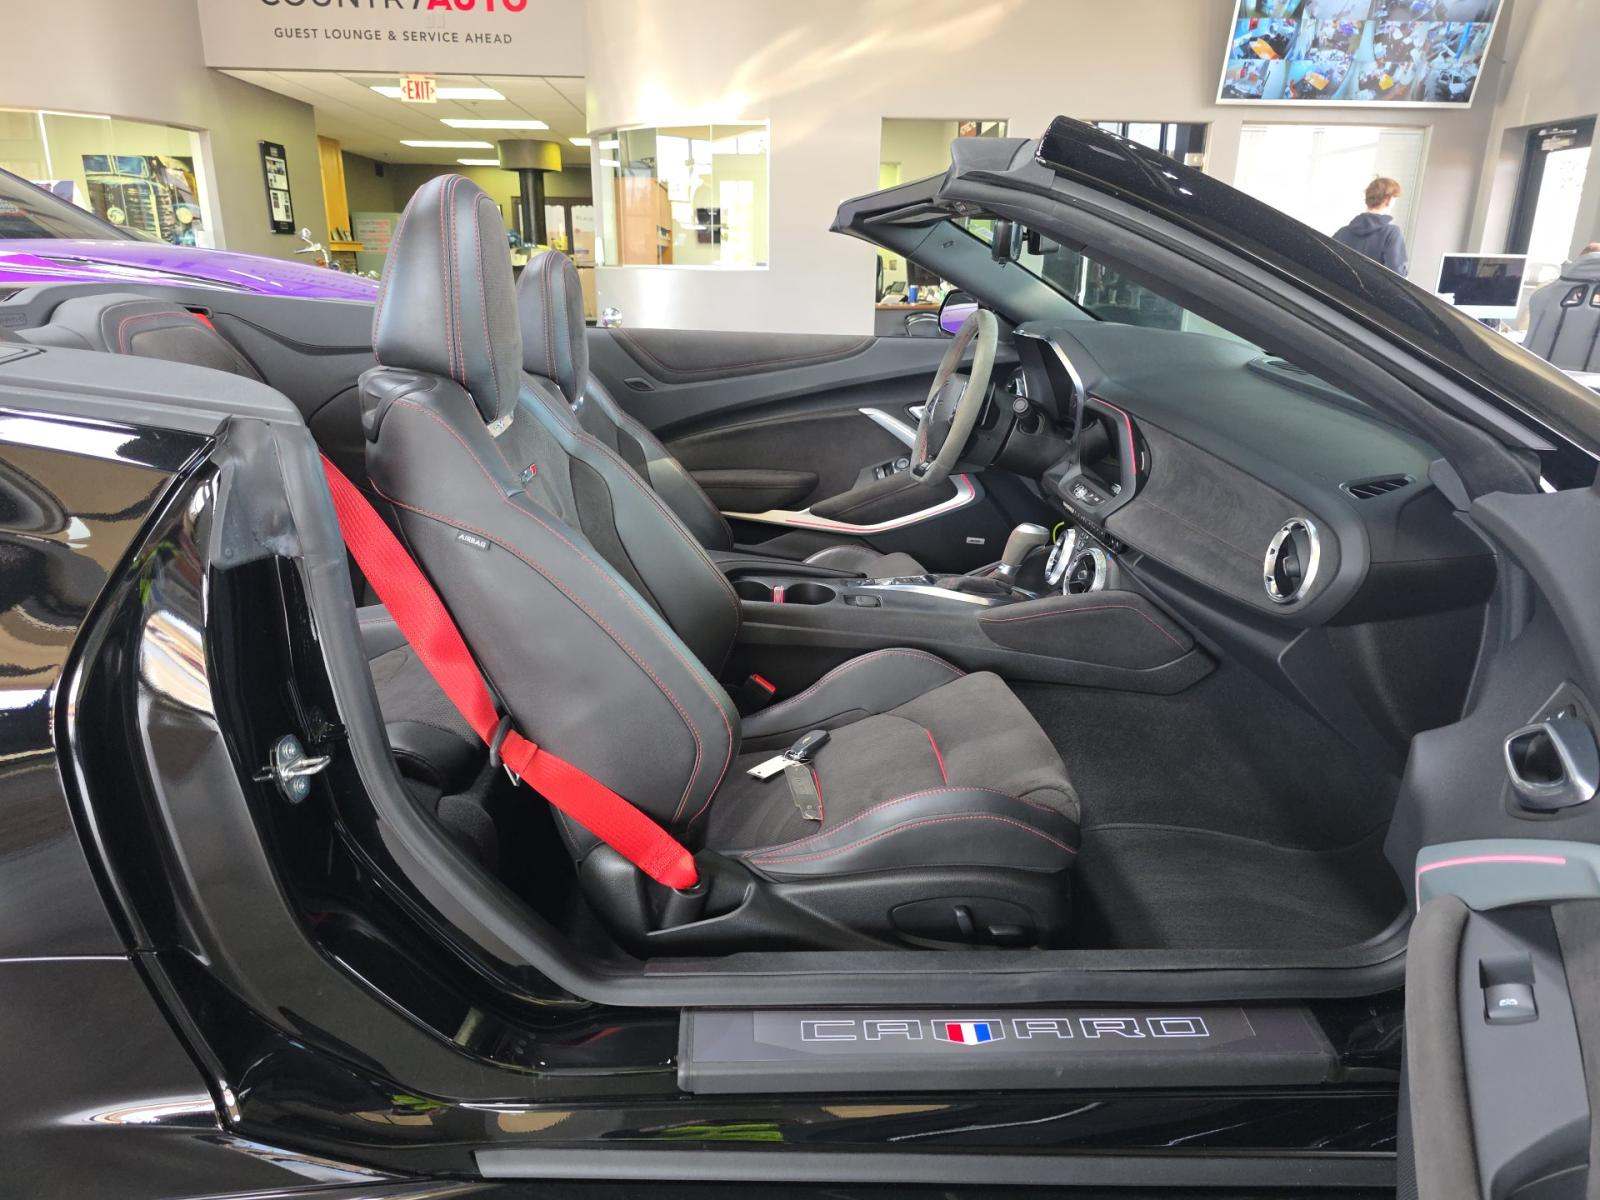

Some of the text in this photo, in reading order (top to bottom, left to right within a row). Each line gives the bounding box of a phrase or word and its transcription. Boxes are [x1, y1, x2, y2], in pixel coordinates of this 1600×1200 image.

[274, 27, 512, 44] GUEST LOUNGE & SERVICE AHEAD
[407, 80, 430, 100] EXIT
[458, 534, 487, 548] AIRBAG
